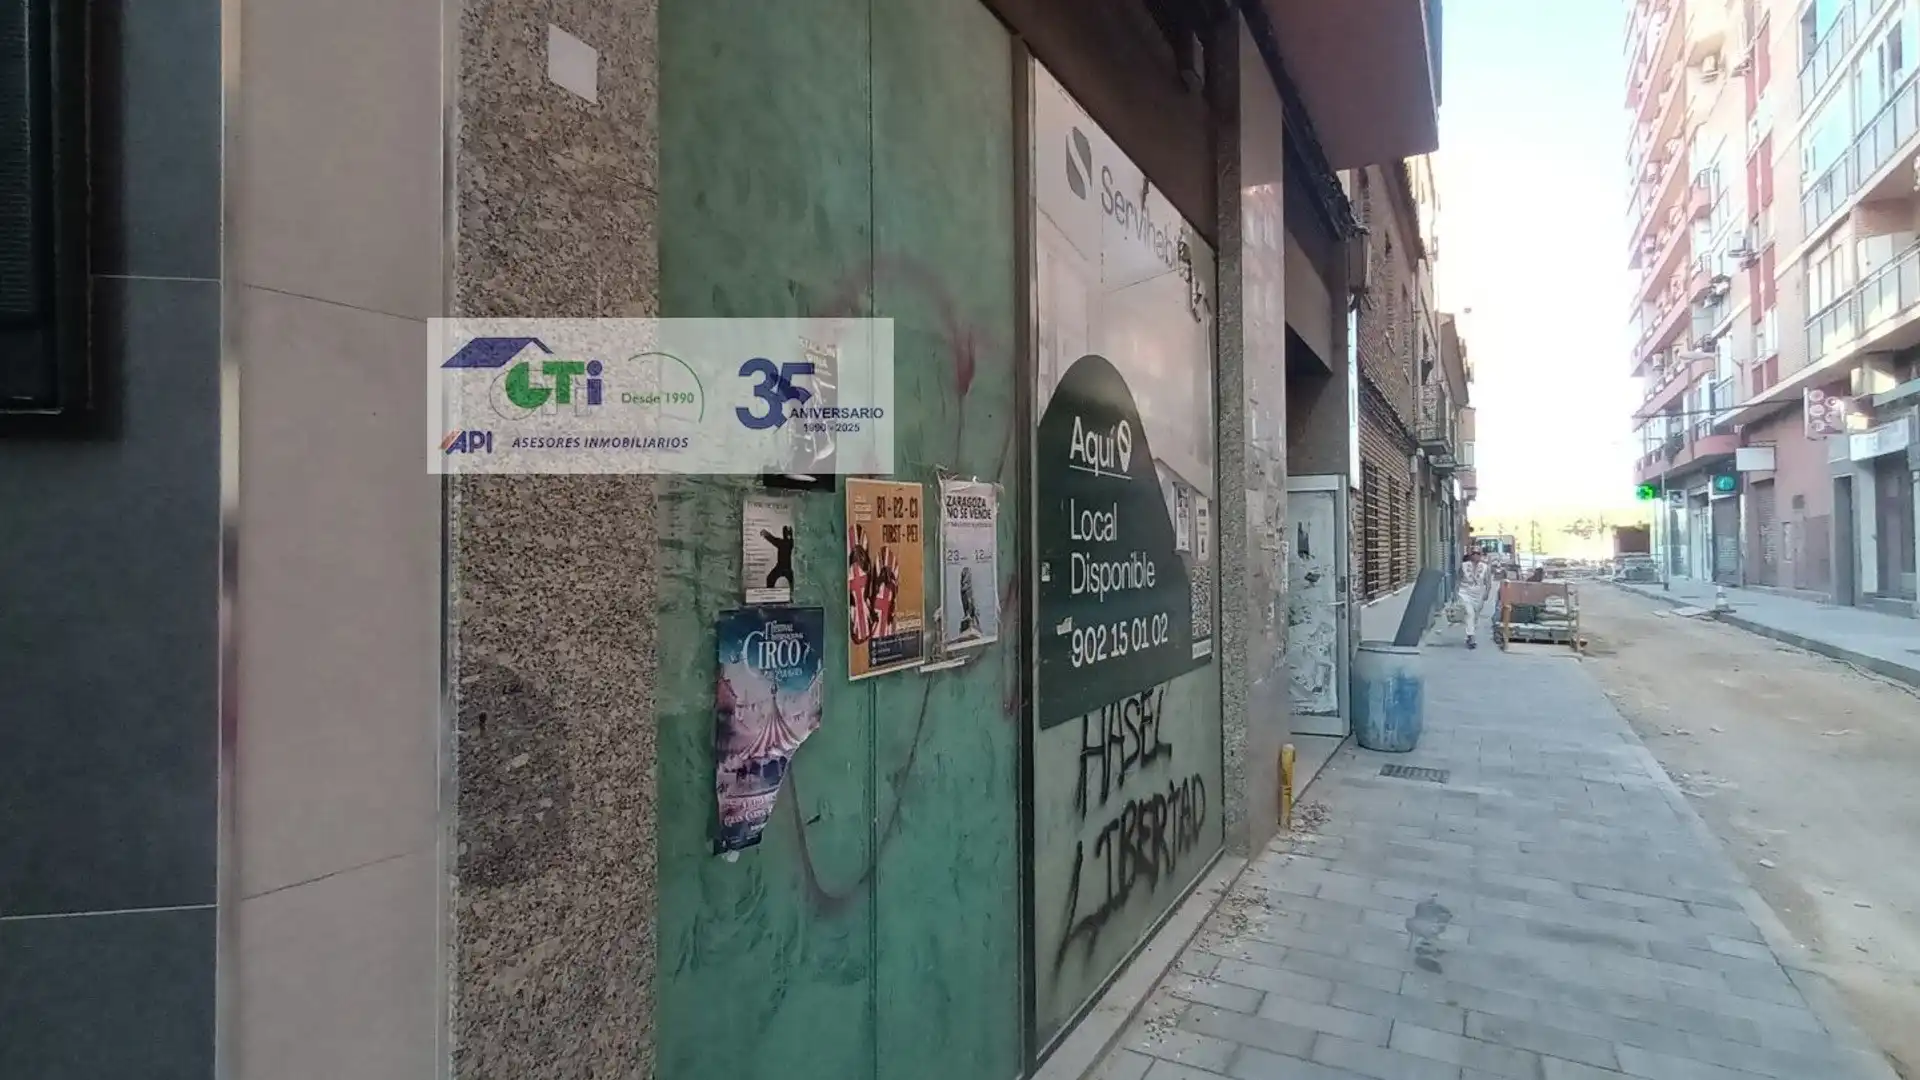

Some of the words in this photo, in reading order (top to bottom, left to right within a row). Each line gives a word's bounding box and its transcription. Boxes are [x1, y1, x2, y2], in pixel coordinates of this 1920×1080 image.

[1069, 415, 1115, 477] Aquí
[946, 495, 987, 508] ZARAGOZA
[946, 507, 959, 519] NO
[960, 507, 968, 519] SE
[969, 508, 992, 520] VENDE
[1070, 498, 1118, 542] Local
[946, 549, 960, 561] 23
[1070, 551, 1156, 603] Disponible
[742, 630, 801, 678] CIRCO
[1071, 624, 1107, 668] 902
[1110, 620, 1128, 658] 15
[1131, 616, 1149, 652] 01
[1151, 612, 1169, 647] 02
